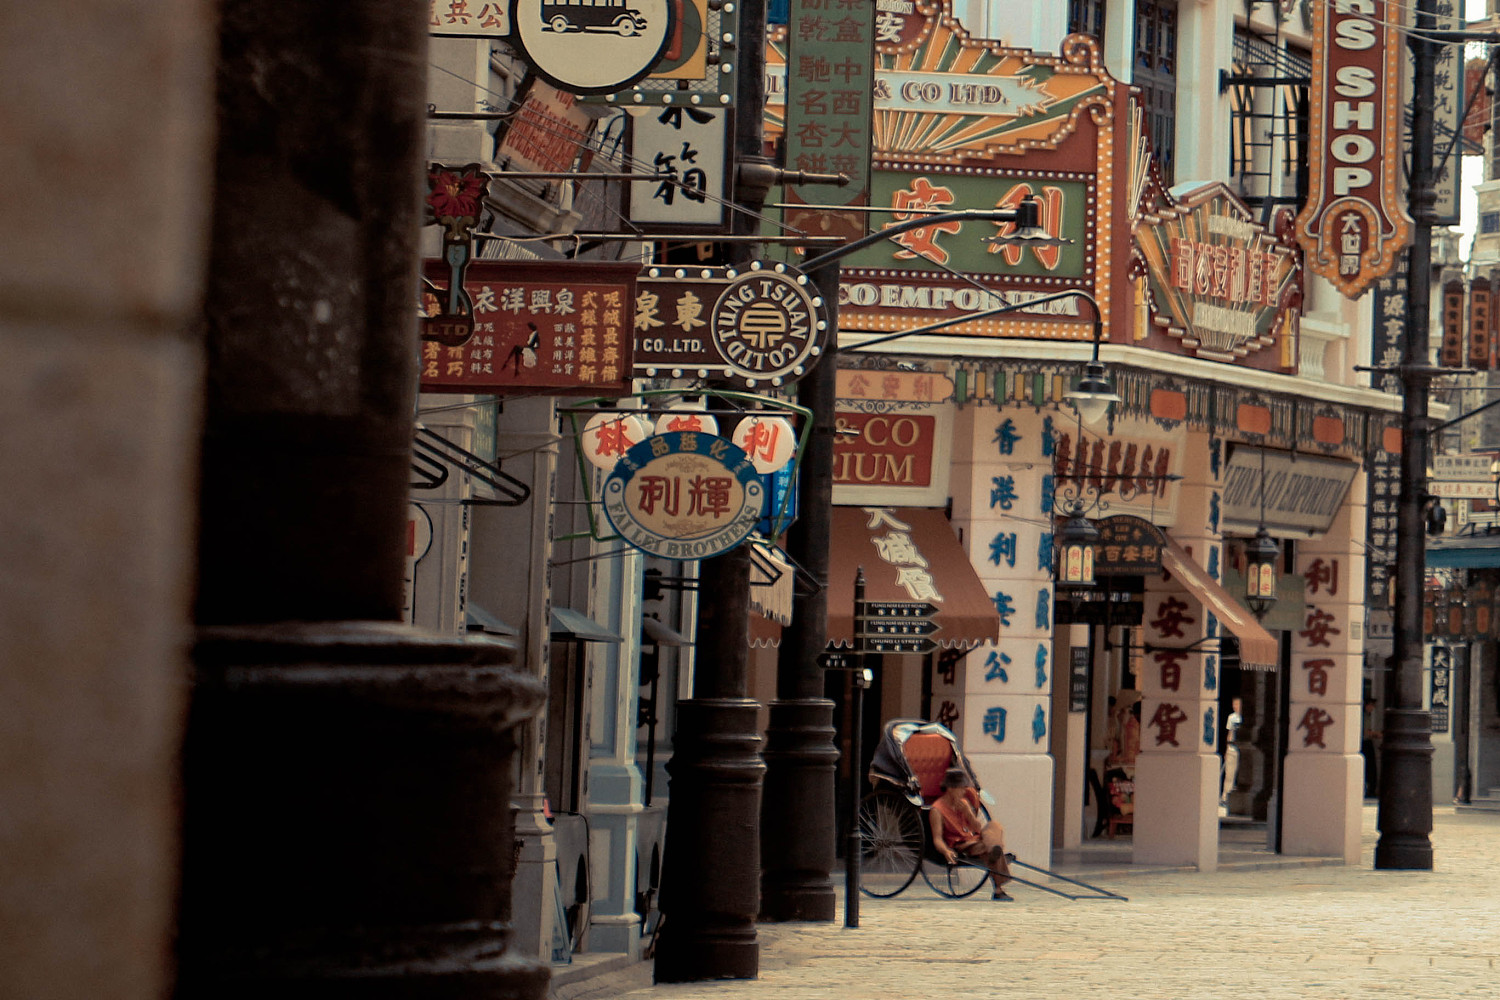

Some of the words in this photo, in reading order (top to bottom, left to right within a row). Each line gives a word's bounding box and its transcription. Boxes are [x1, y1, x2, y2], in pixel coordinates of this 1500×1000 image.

[901, 79, 942, 104] CO
[949, 82, 1010, 106] LTD.
[1330, 65, 1376, 196] SHOP
[717, 284, 756, 343] TUNG
[760, 280, 809, 341] TSUAN
[879, 284, 1080, 317] EMPORIUM
[861, 414, 918, 444] CO
[666, 503, 759, 558] BROTHERS
[1148, 546, 1194, 748] 安百貨
